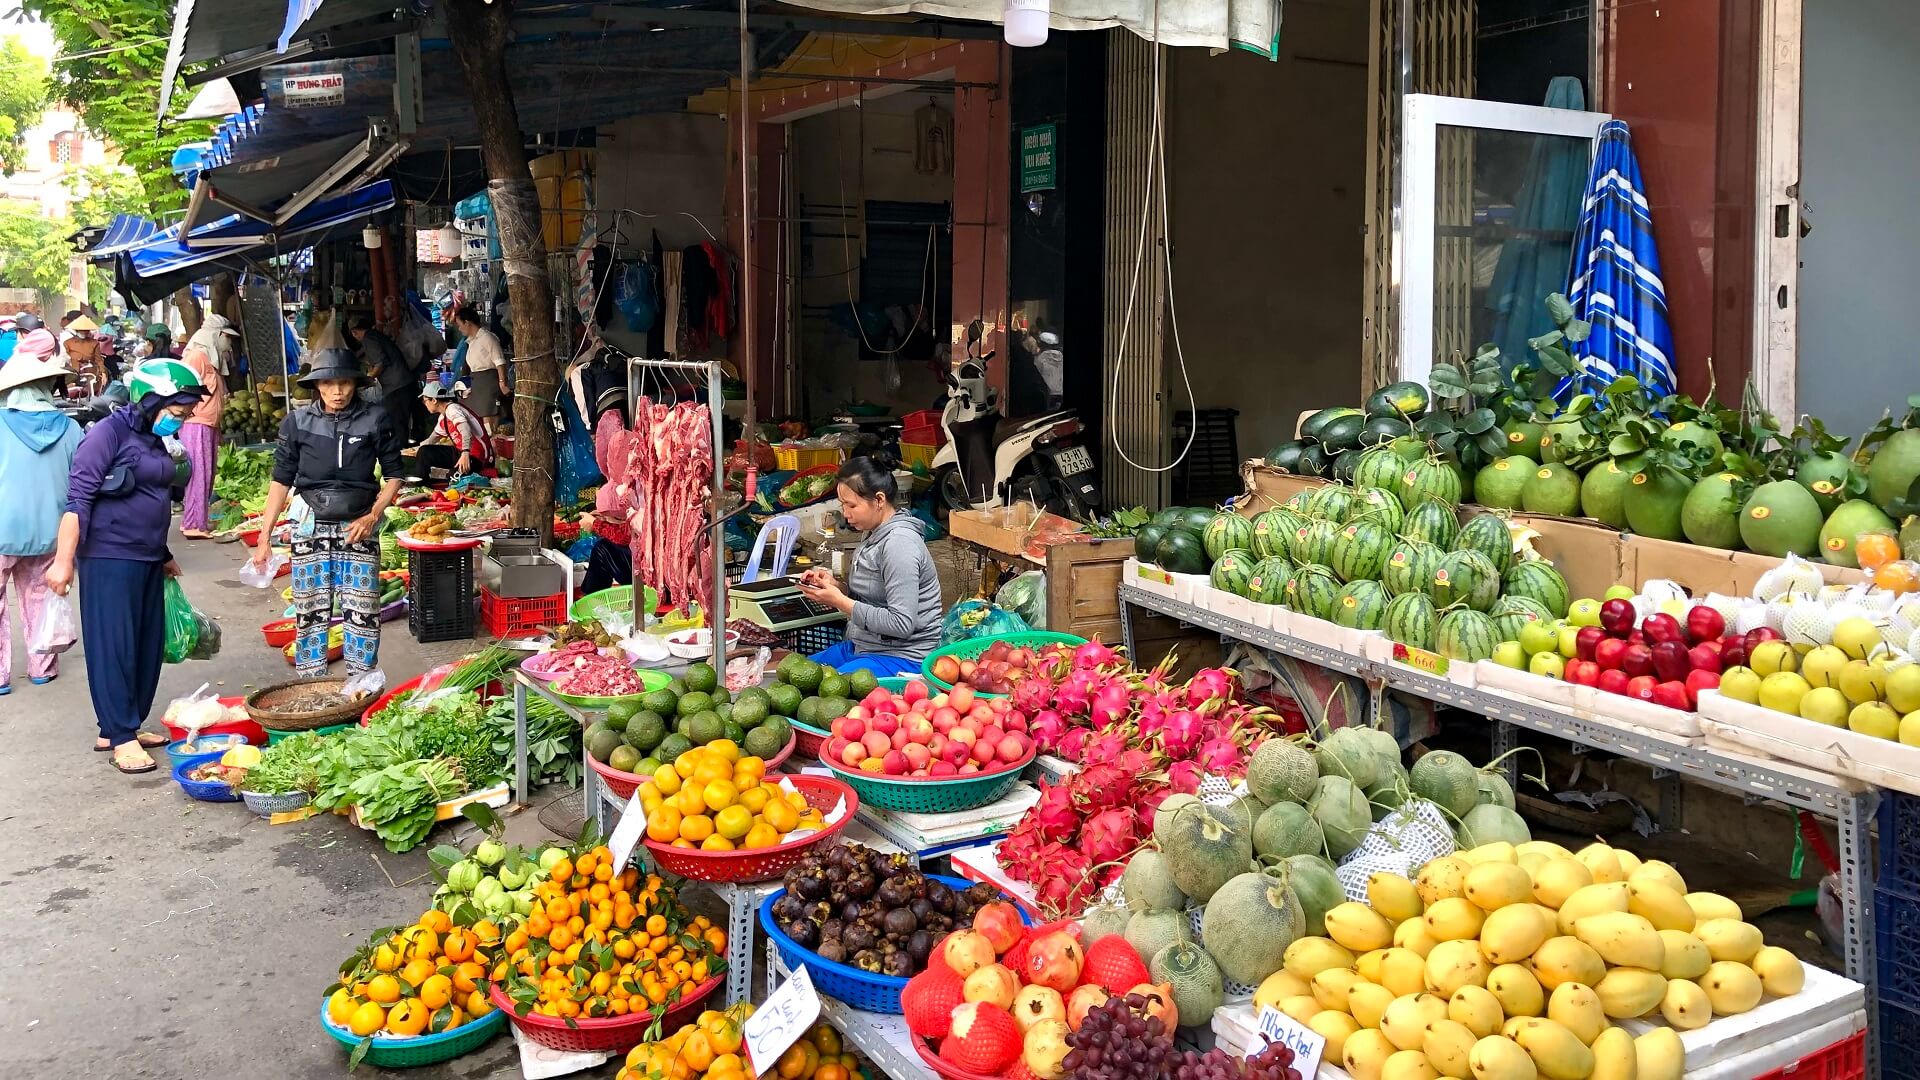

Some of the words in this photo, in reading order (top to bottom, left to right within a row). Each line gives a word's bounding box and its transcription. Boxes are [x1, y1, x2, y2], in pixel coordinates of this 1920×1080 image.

[285, 80, 296, 89] HP
[321, 76, 342, 88] PHÁT
[1414, 655, 1436, 670] 666
[748, 1005, 784, 1054] 50
